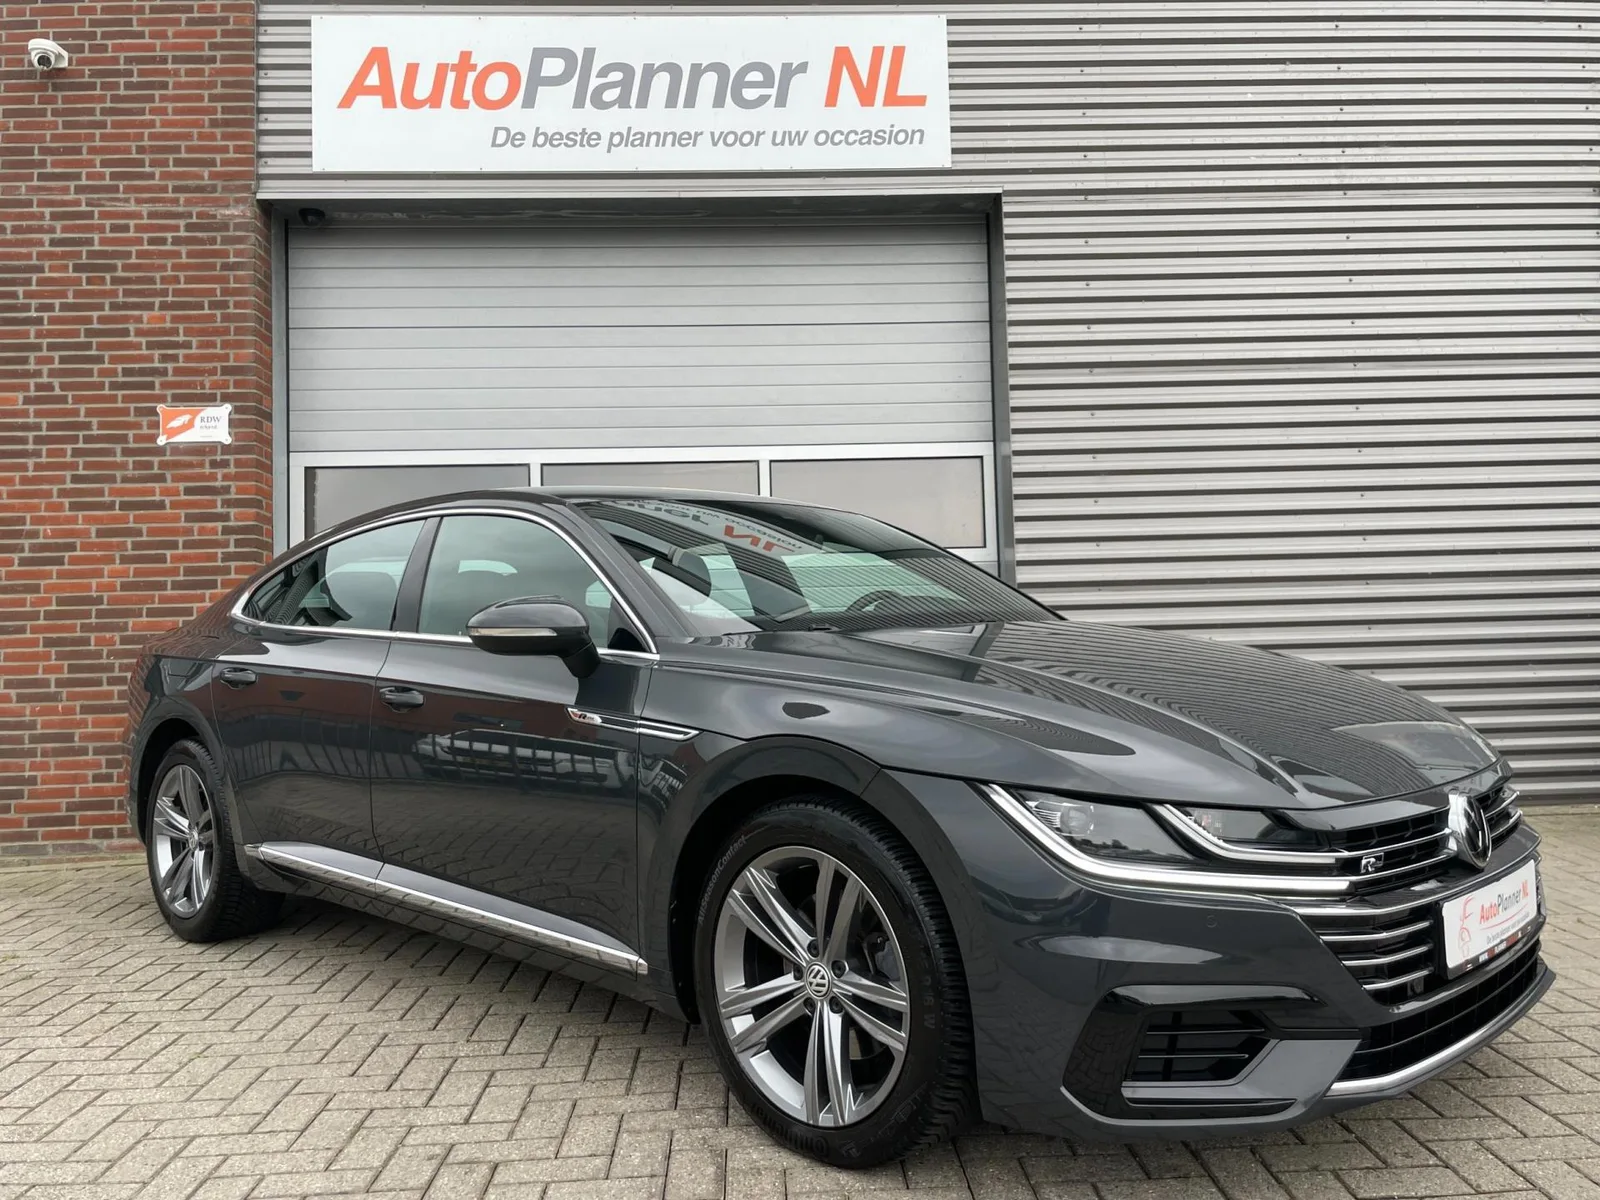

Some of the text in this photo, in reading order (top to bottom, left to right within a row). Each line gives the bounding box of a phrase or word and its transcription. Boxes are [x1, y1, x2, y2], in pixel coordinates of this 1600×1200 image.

[336, 45, 927, 111] AutoPlanner NL
[490, 124, 925, 153] De beste planner voor uw occasion
[200, 416, 221, 424] RDW
[1479, 887, 1521, 924] AutoPlanner
